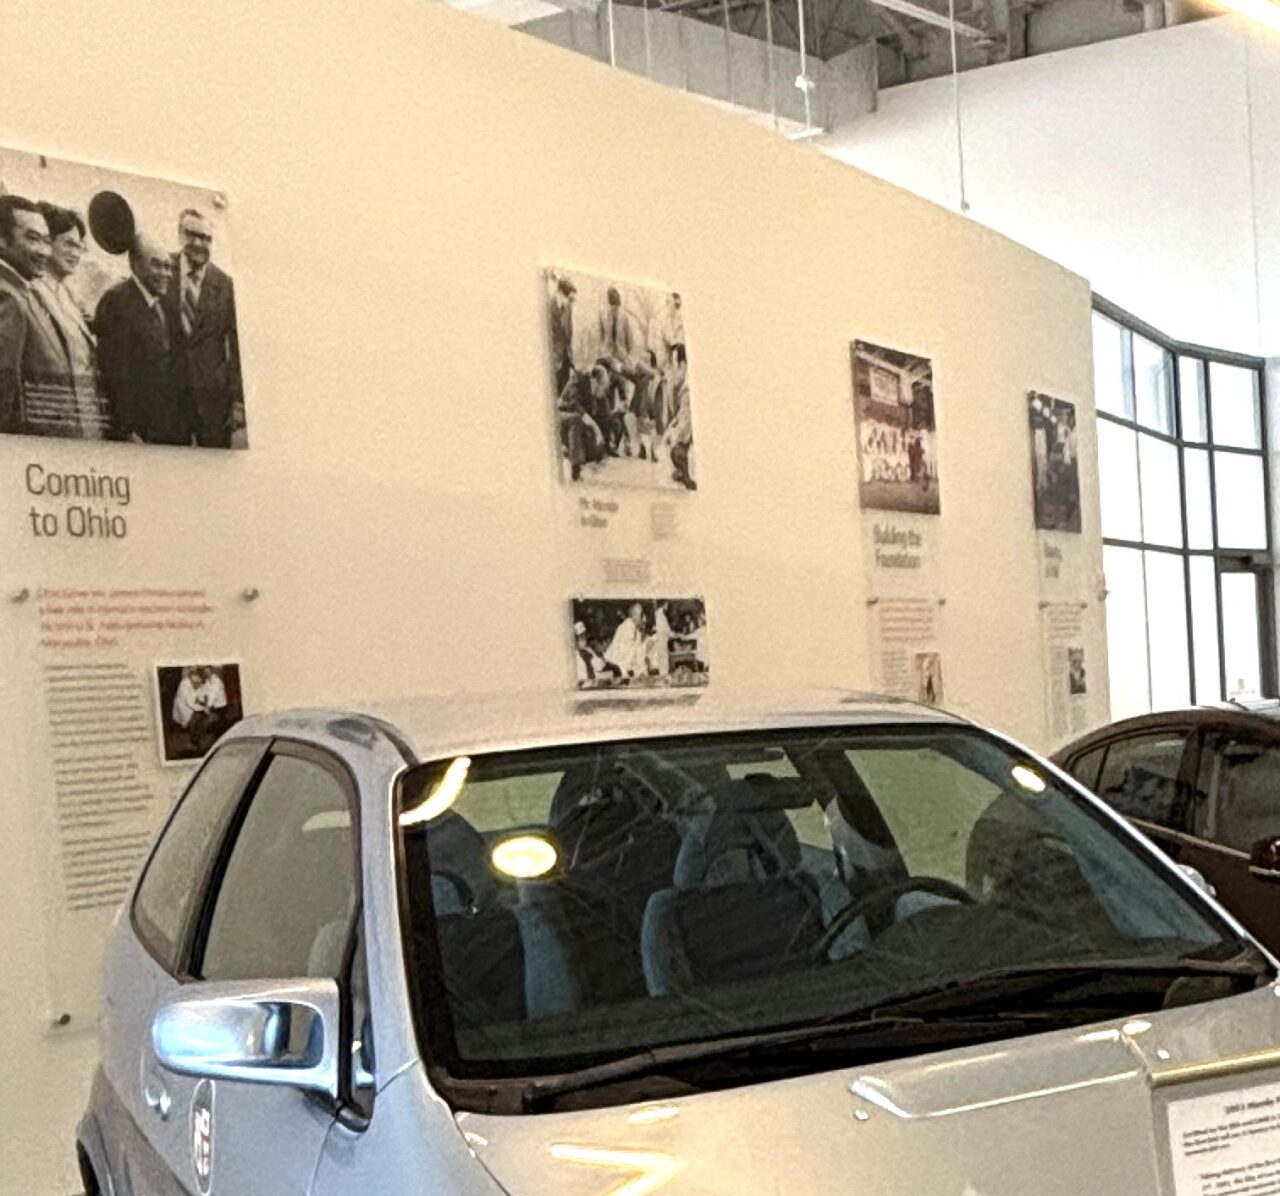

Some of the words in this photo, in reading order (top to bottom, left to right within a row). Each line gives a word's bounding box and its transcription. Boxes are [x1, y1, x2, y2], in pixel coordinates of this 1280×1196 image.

[25, 463, 131, 506] Coming
[28, 505, 58, 537] to
[66, 505, 127, 538] Ohio
